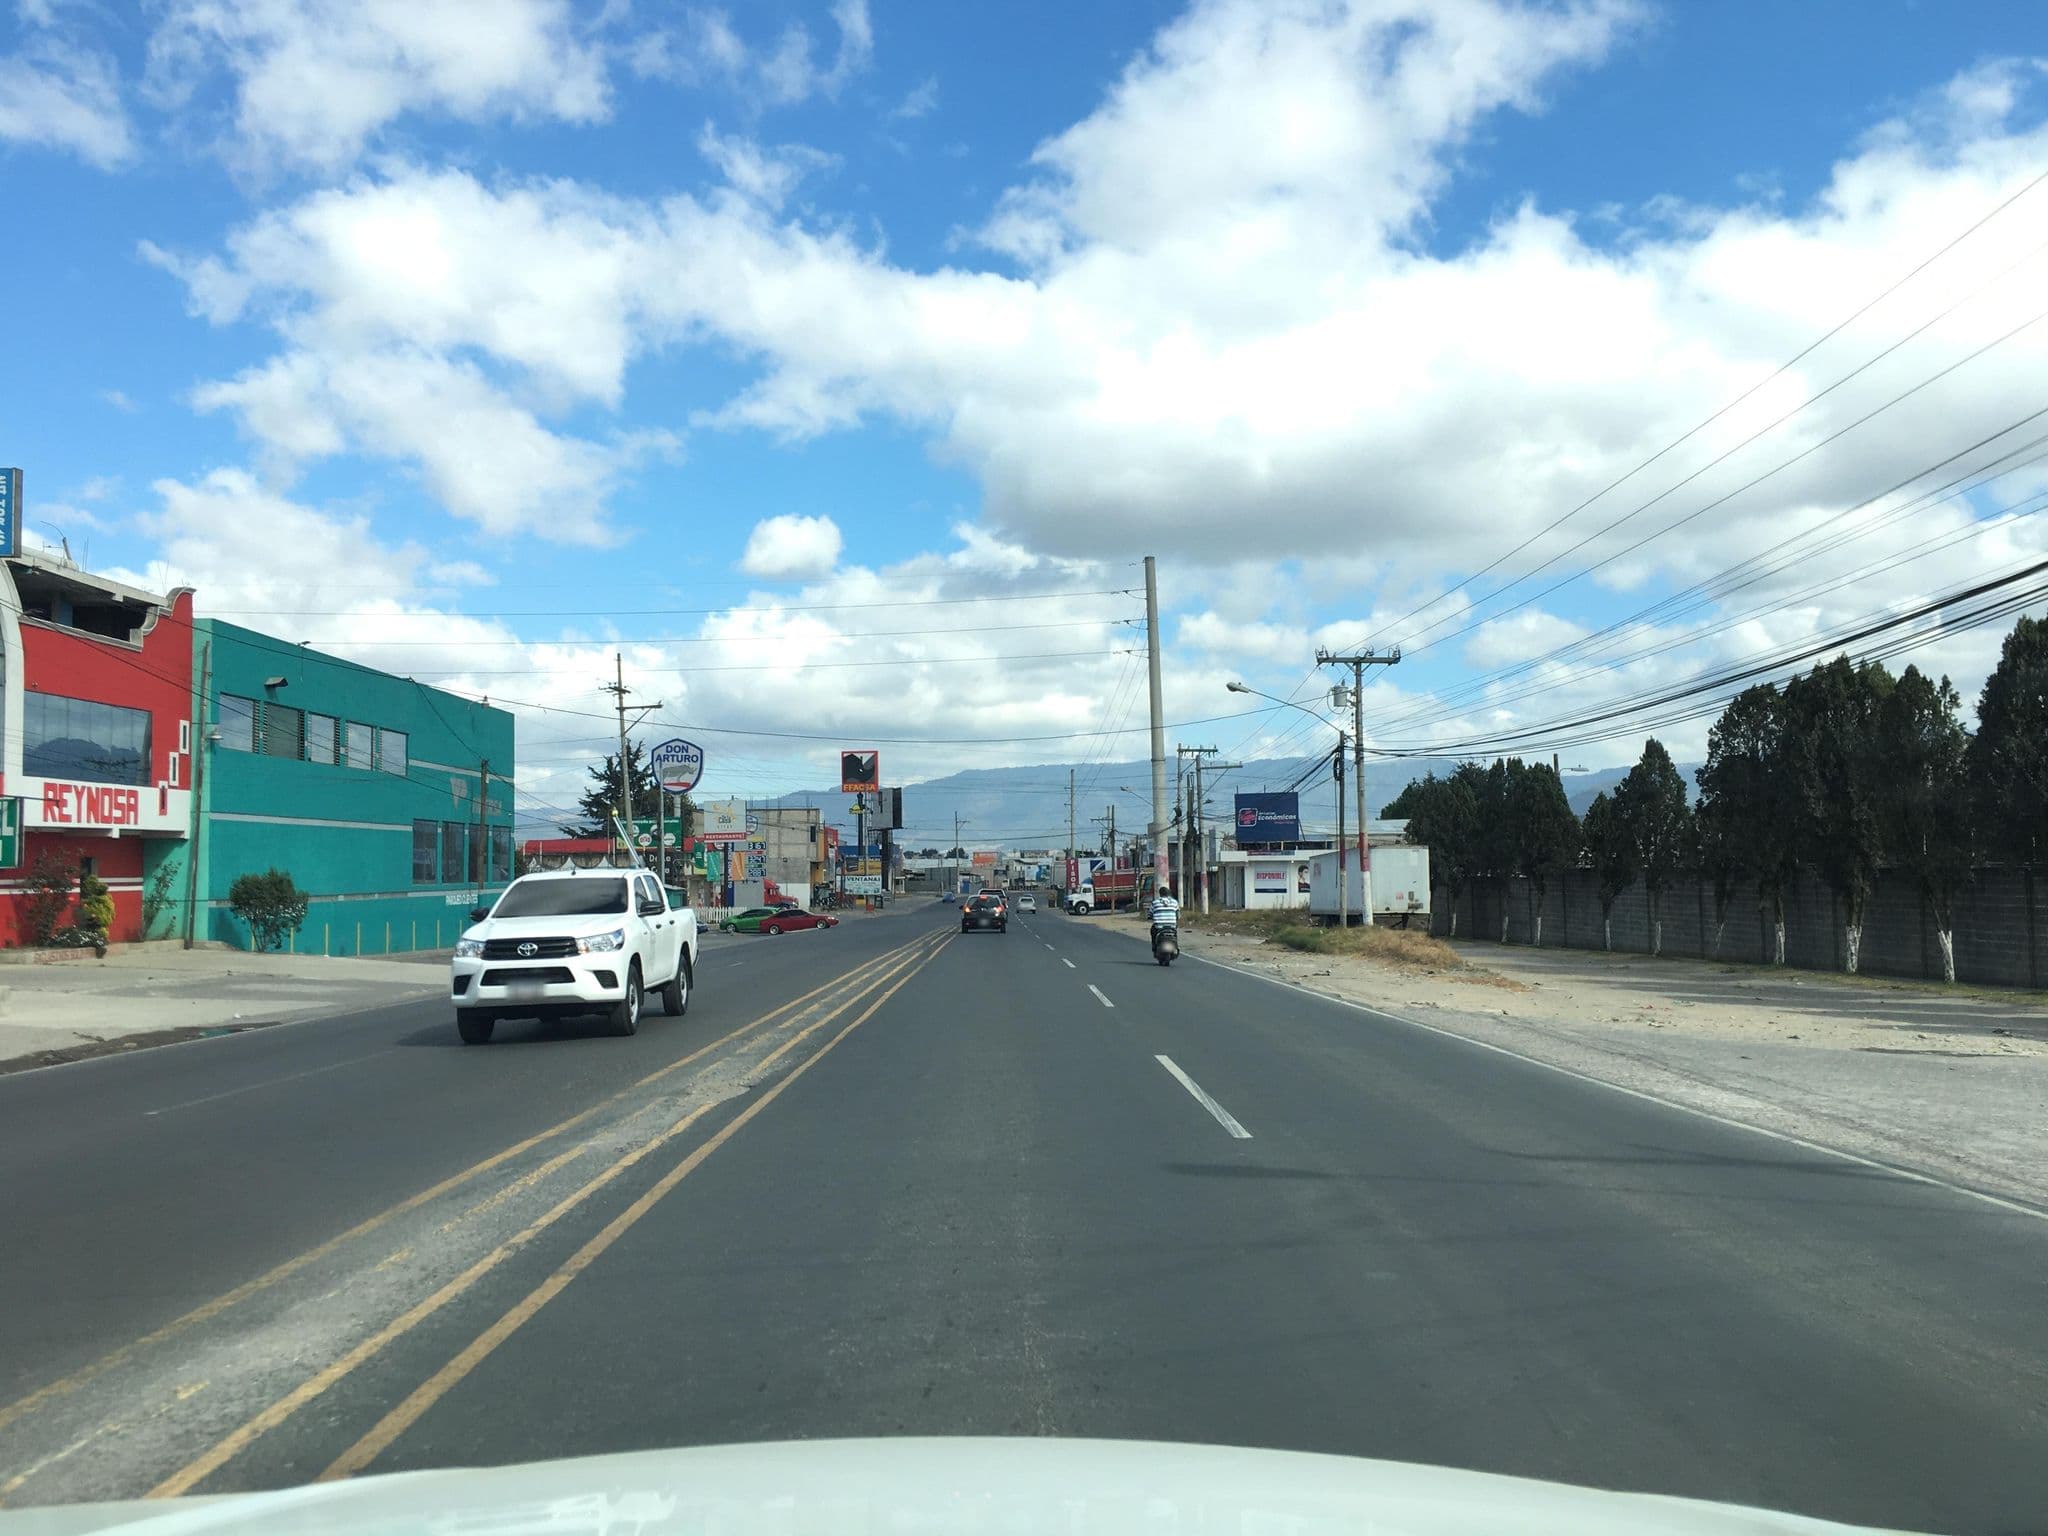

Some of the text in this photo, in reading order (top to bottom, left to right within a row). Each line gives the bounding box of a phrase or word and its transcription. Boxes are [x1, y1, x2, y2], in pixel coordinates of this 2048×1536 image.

[666, 745, 689, 754] DON
[655, 754, 699, 763] ARTURO
[43, 782, 138, 825] REYNOSA
